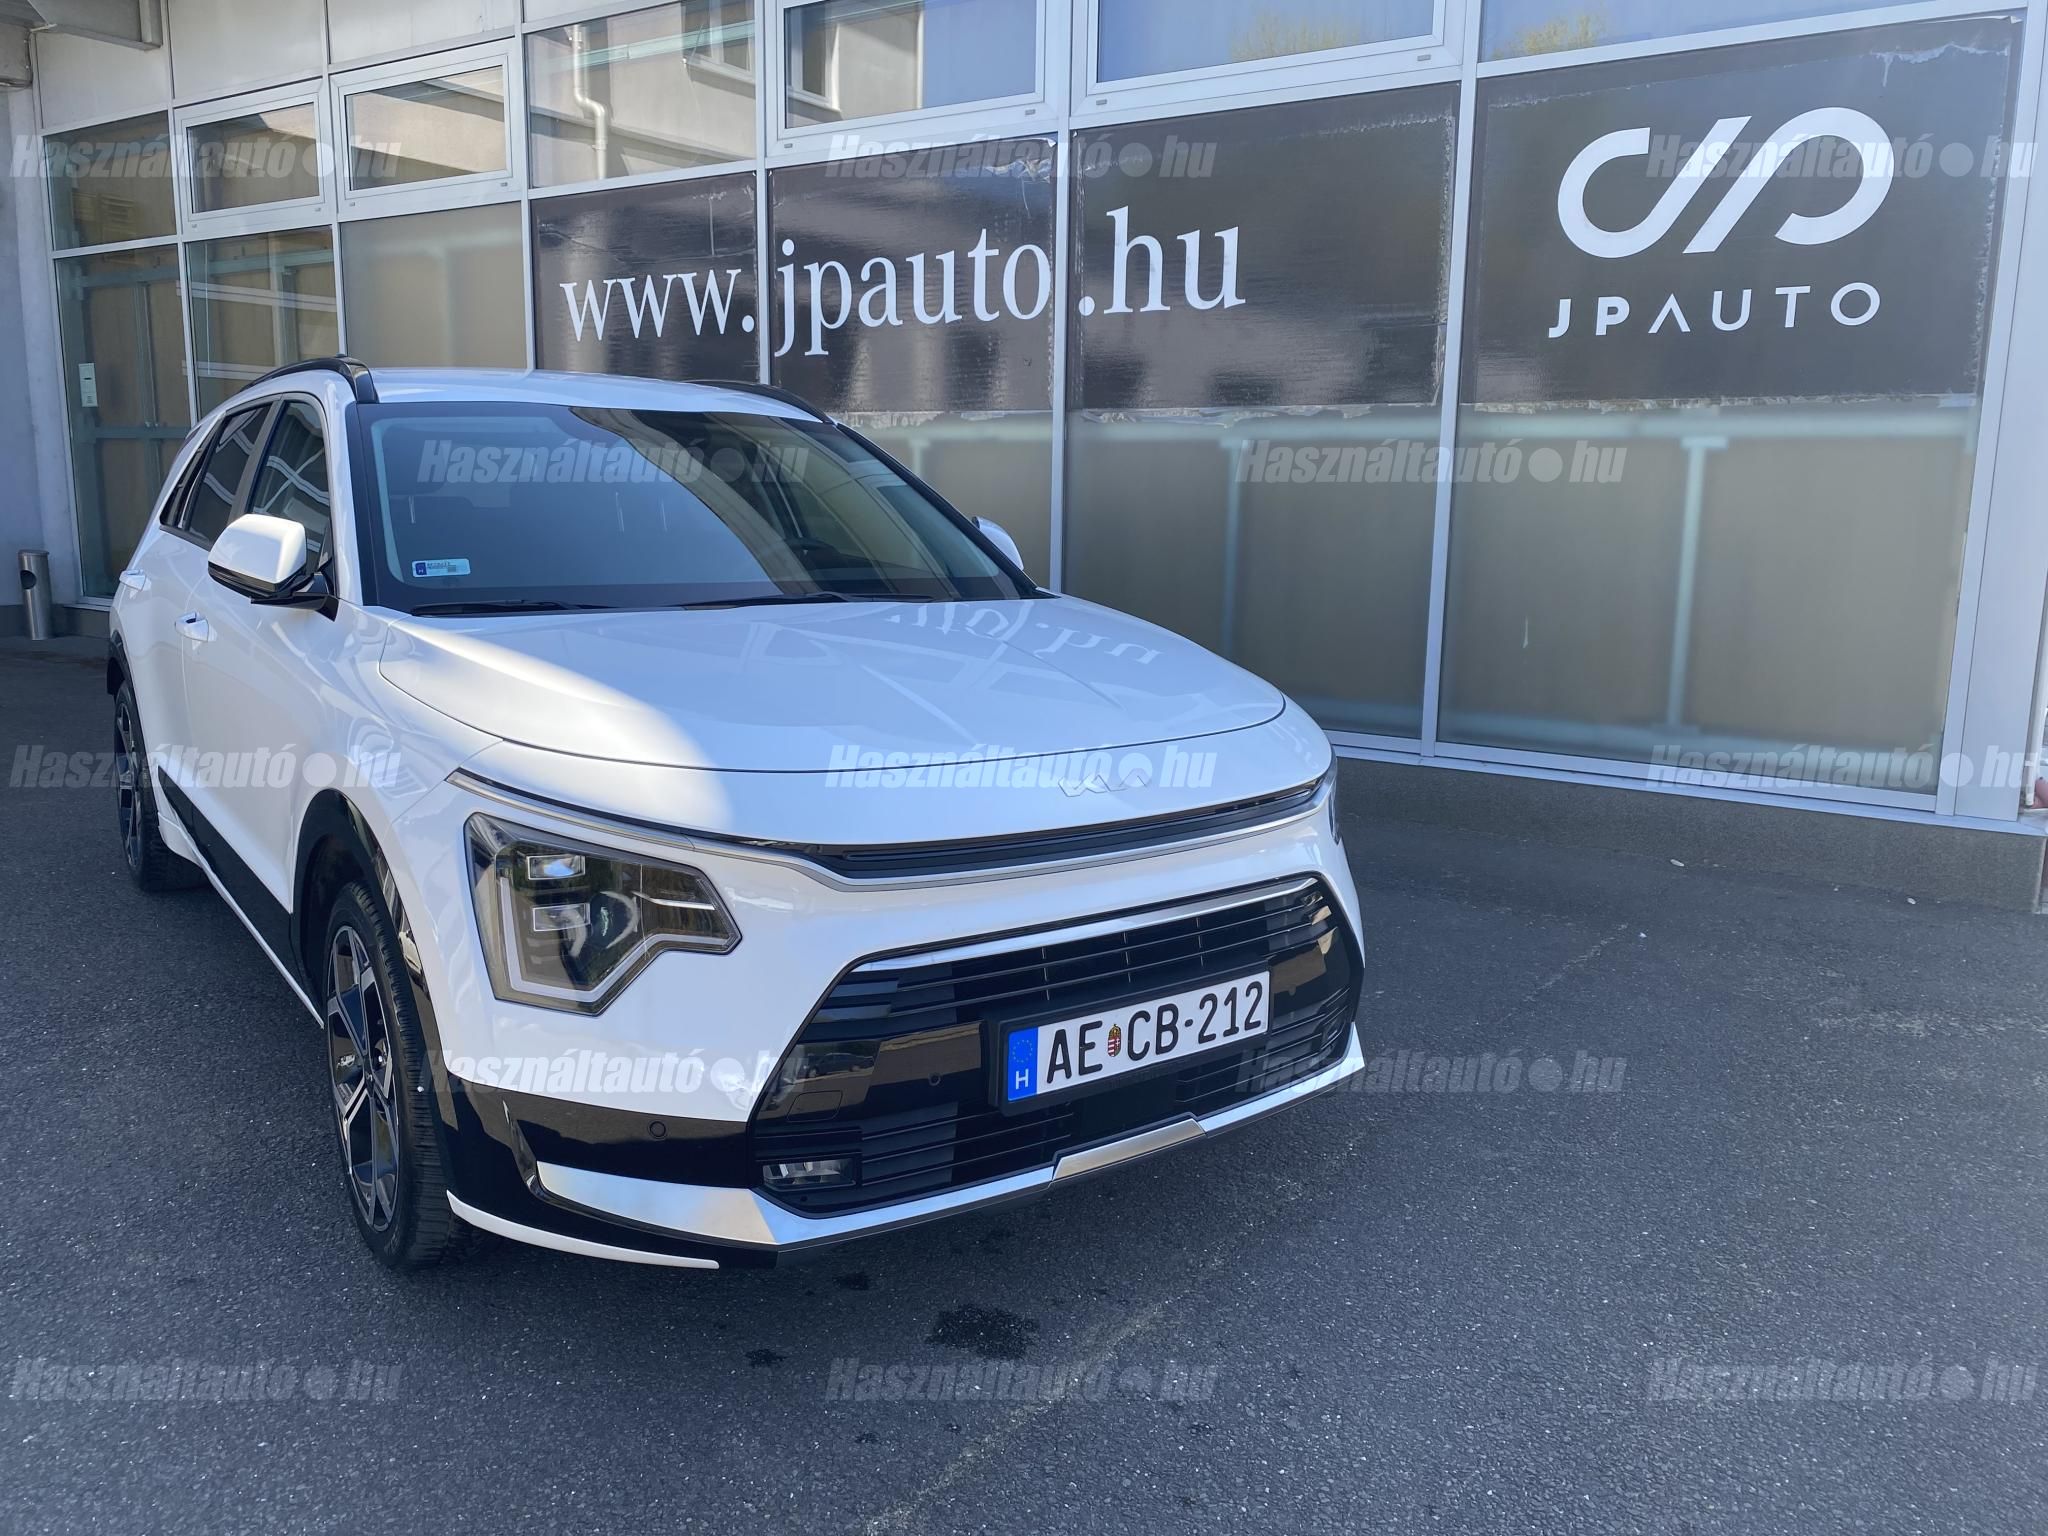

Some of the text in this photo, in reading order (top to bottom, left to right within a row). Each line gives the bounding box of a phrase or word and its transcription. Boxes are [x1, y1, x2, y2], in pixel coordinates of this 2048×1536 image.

[1548, 281, 1881, 338] JPAUTO
[1046, 981, 1263, 1084] AE CB-212
[1015, 1068, 1029, 1090] H
